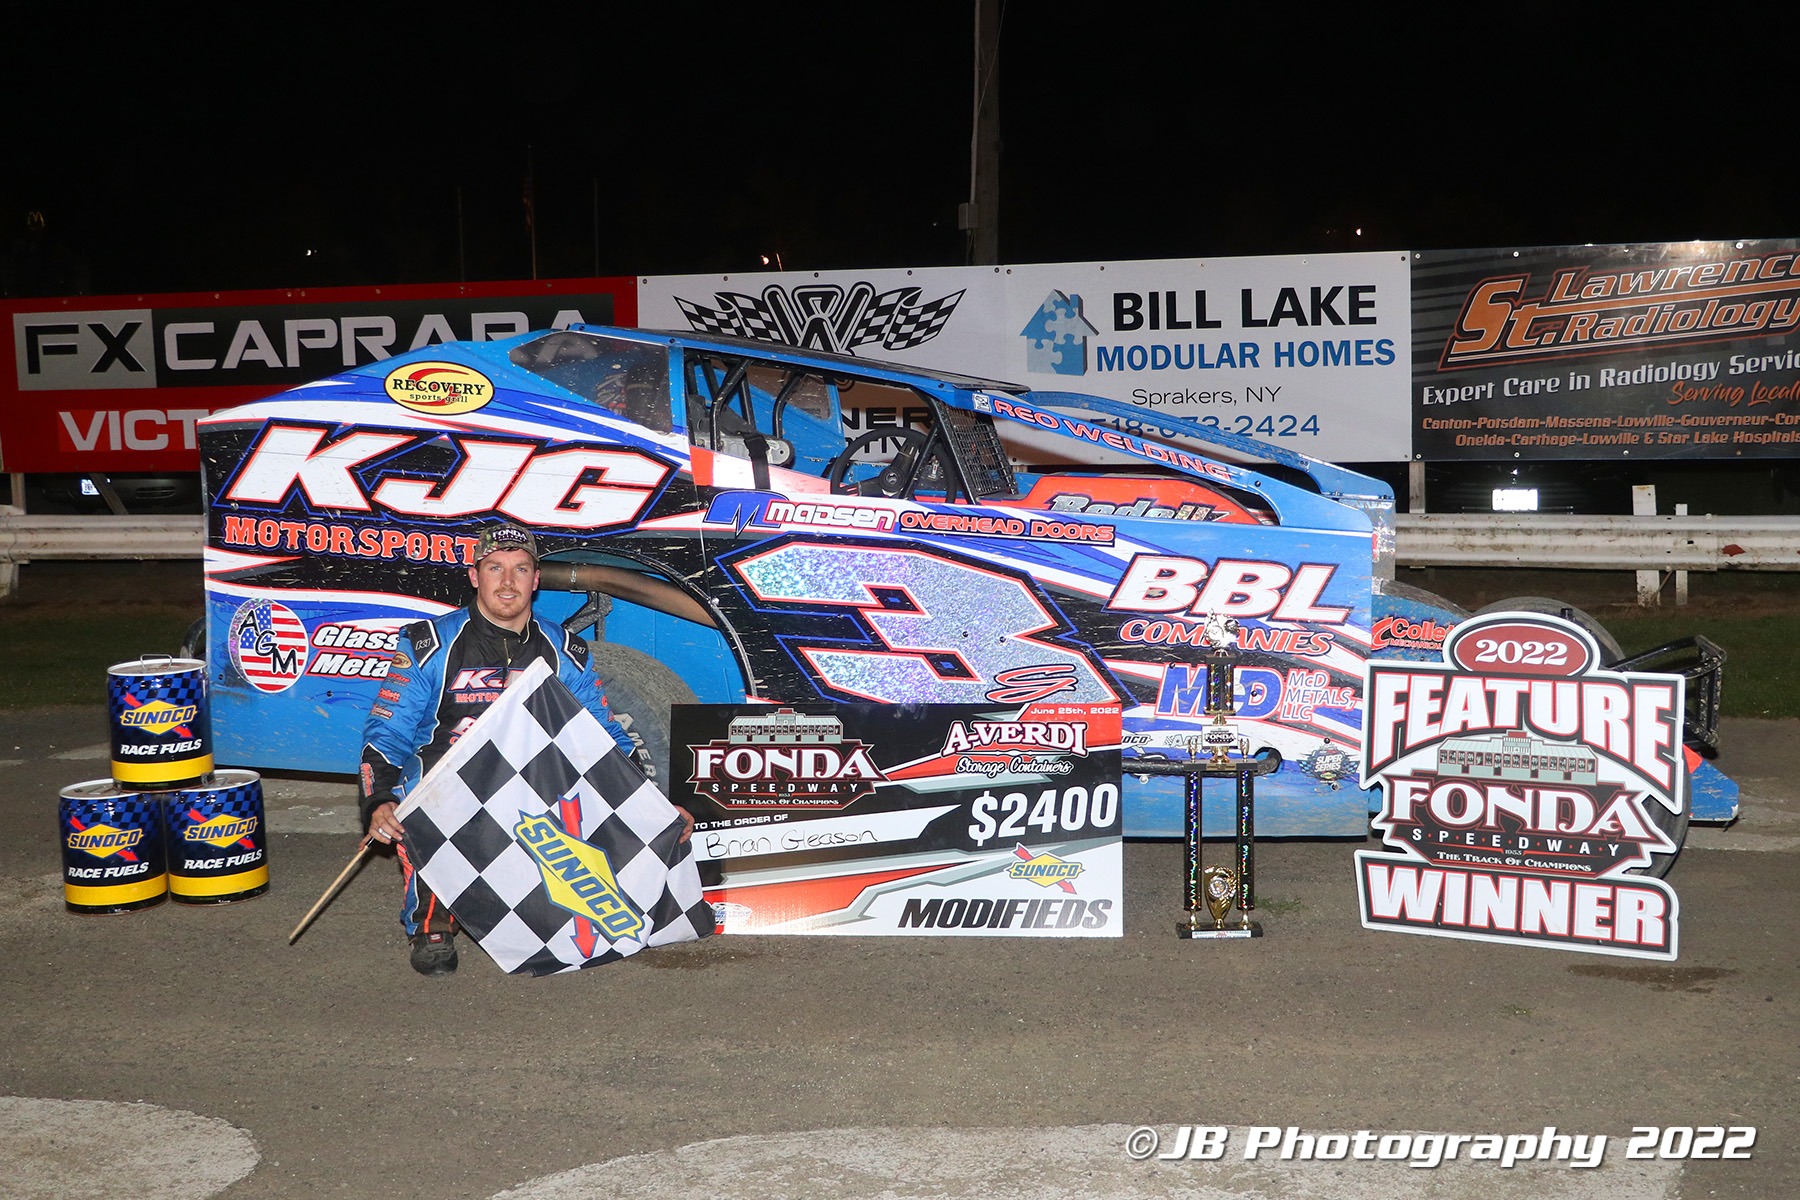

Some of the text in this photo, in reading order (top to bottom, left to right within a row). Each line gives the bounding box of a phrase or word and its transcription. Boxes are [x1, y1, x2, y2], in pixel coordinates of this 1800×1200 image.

[1113, 285, 1377, 332] BILL LAKE
[1451, 279, 1557, 355] St.
[1560, 298, 1800, 344] Radiology
[25, 320, 148, 375] FX
[1096, 338, 1396, 372] MODULAR HOMES
[392, 378, 486, 396] RECOVERY
[409, 392, 468, 404] sports grill
[1132, 386, 1282, 408] Sprakers, NY
[1423, 382, 1495, 406] Expert
[1503, 377, 1561, 397] Care
[1569, 371, 1591, 391] in
[1600, 361, 1721, 388] Radiology
[1667, 381, 1745, 407] Serving
[59, 408, 234, 451] VICT
[994, 399, 1233, 481] REO WELDING
[1643, 431, 1654, 444] &
[1658, 431, 1690, 445] Star
[1694, 430, 1729, 444] Lake
[227, 427, 669, 528] KJG
[900, 511, 1023, 536] OVERHEAD
[1029, 518, 1114, 541] DOORS
[1106, 554, 1352, 623] BBL
[735, 543, 1120, 704] 3
[1120, 619, 1335, 655] COMANIES
[238, 610, 298, 675] AGM
[313, 626, 399, 651] Glass
[1475, 638, 1568, 665] 2022
[1288, 671, 1326, 688] McD
[1030, 707, 1120, 716] June 25th, 2022
[1282, 704, 1312, 721] LLC
[1285, 688, 1356, 709] METALS,
[123, 706, 196, 725] SUNOCO
[943, 722, 1087, 755] A-VERDI
[1204, 732, 1236, 741] FONDA
[1371, 673, 1672, 790] FEATURE
[120, 738, 202, 755] RACE FUELS
[695, 749, 879, 779] FONDA
[956, 757, 1073, 777] Storage Containers
[693, 814, 788, 830] TO THE ORDER OF
[968, 783, 1119, 847] $2400
[1392, 779, 1653, 842] FONDA
[70, 828, 142, 849] SUNOCO
[186, 817, 257, 840] SUNOCO
[706, 829, 878, 858] Brian Gleason
[68, 862, 149, 878] RACE FUELS
[184, 849, 262, 870] RACE FUELS
[1012, 864, 1080, 877] SUNOCO
[1437, 851, 1461, 860] THE
[1463, 853, 1502, 865] TRACK
[1524, 858, 1592, 872] CHAMPIONS
[521, 820, 637, 938] SUNOCO
[897, 898, 1112, 929] MODIFIEDS
[1366, 864, 1666, 946] WINNER
